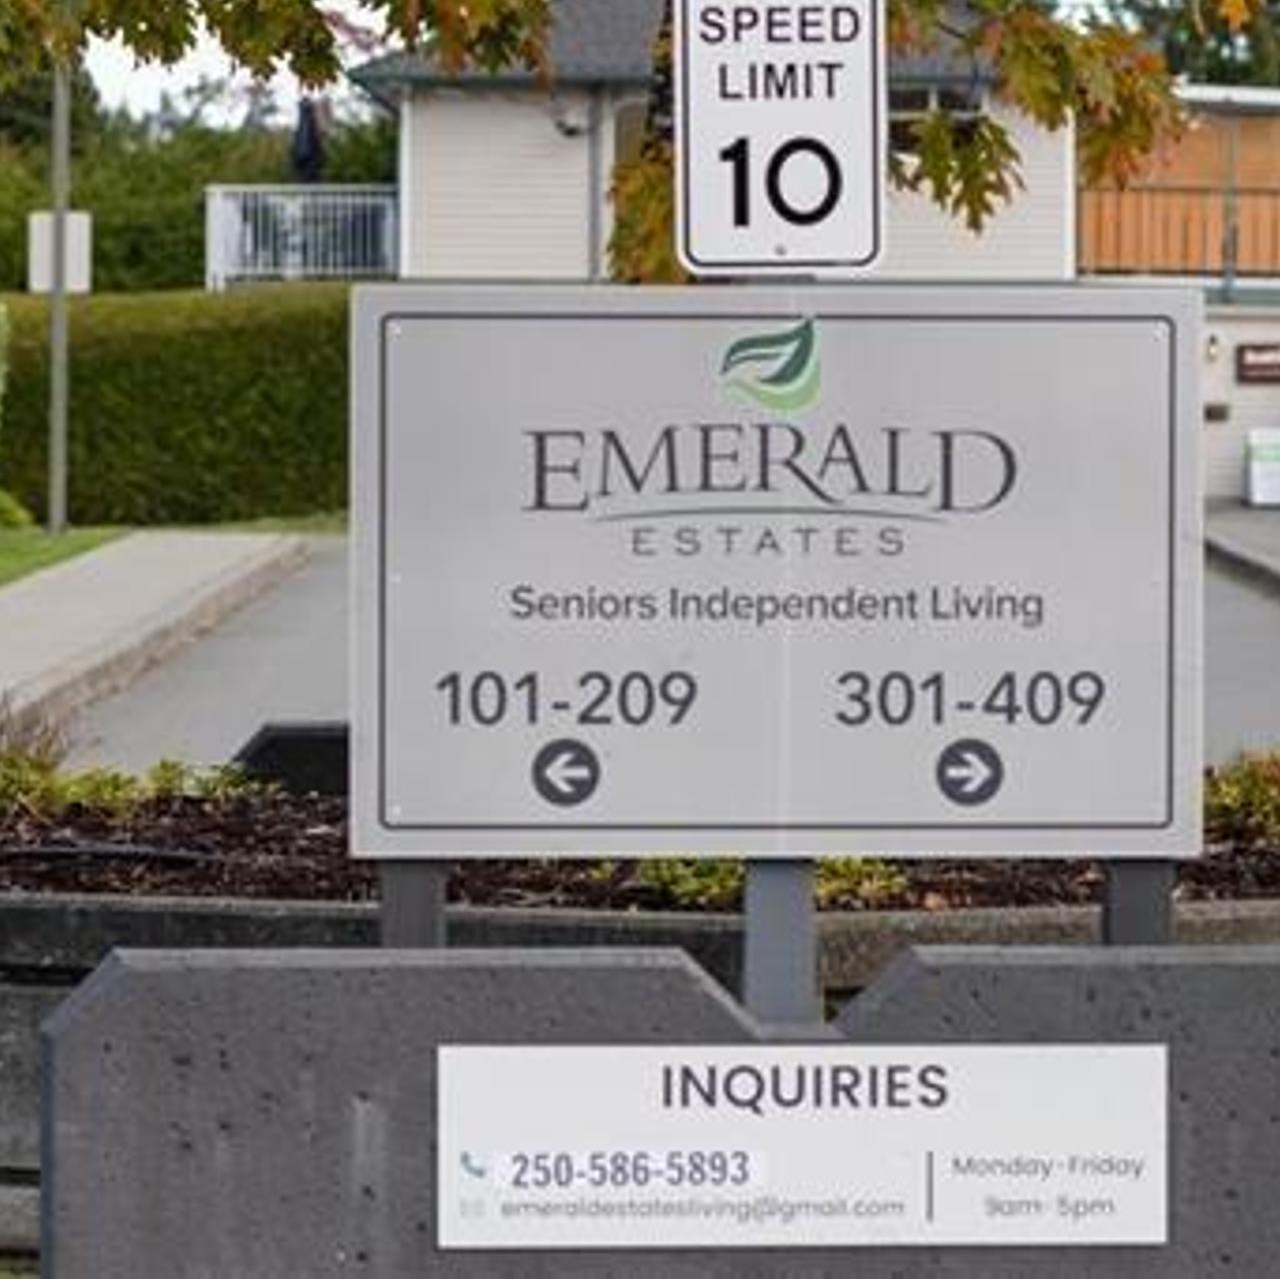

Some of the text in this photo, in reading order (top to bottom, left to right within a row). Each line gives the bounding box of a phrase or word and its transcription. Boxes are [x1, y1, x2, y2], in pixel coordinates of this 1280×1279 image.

[700, 6, 860, 44] SPEED
[718, 62, 844, 100] LIMIT
[718, 136, 842, 228] 10
[522, 424, 1017, 513] EMERALD
[632, 528, 904, 556] ESTATES
[511, 585, 1043, 627] Seniors Independent Living
[437, 670, 698, 727] 101-209
[835, 670, 1106, 727] 301-409
[663, 1064, 948, 1115] INQUIRIES
[512, 1150, 750, 1188] 250-586-5893
[500, 1196, 905, 1224] emeraldestatesliving@gmail.com
